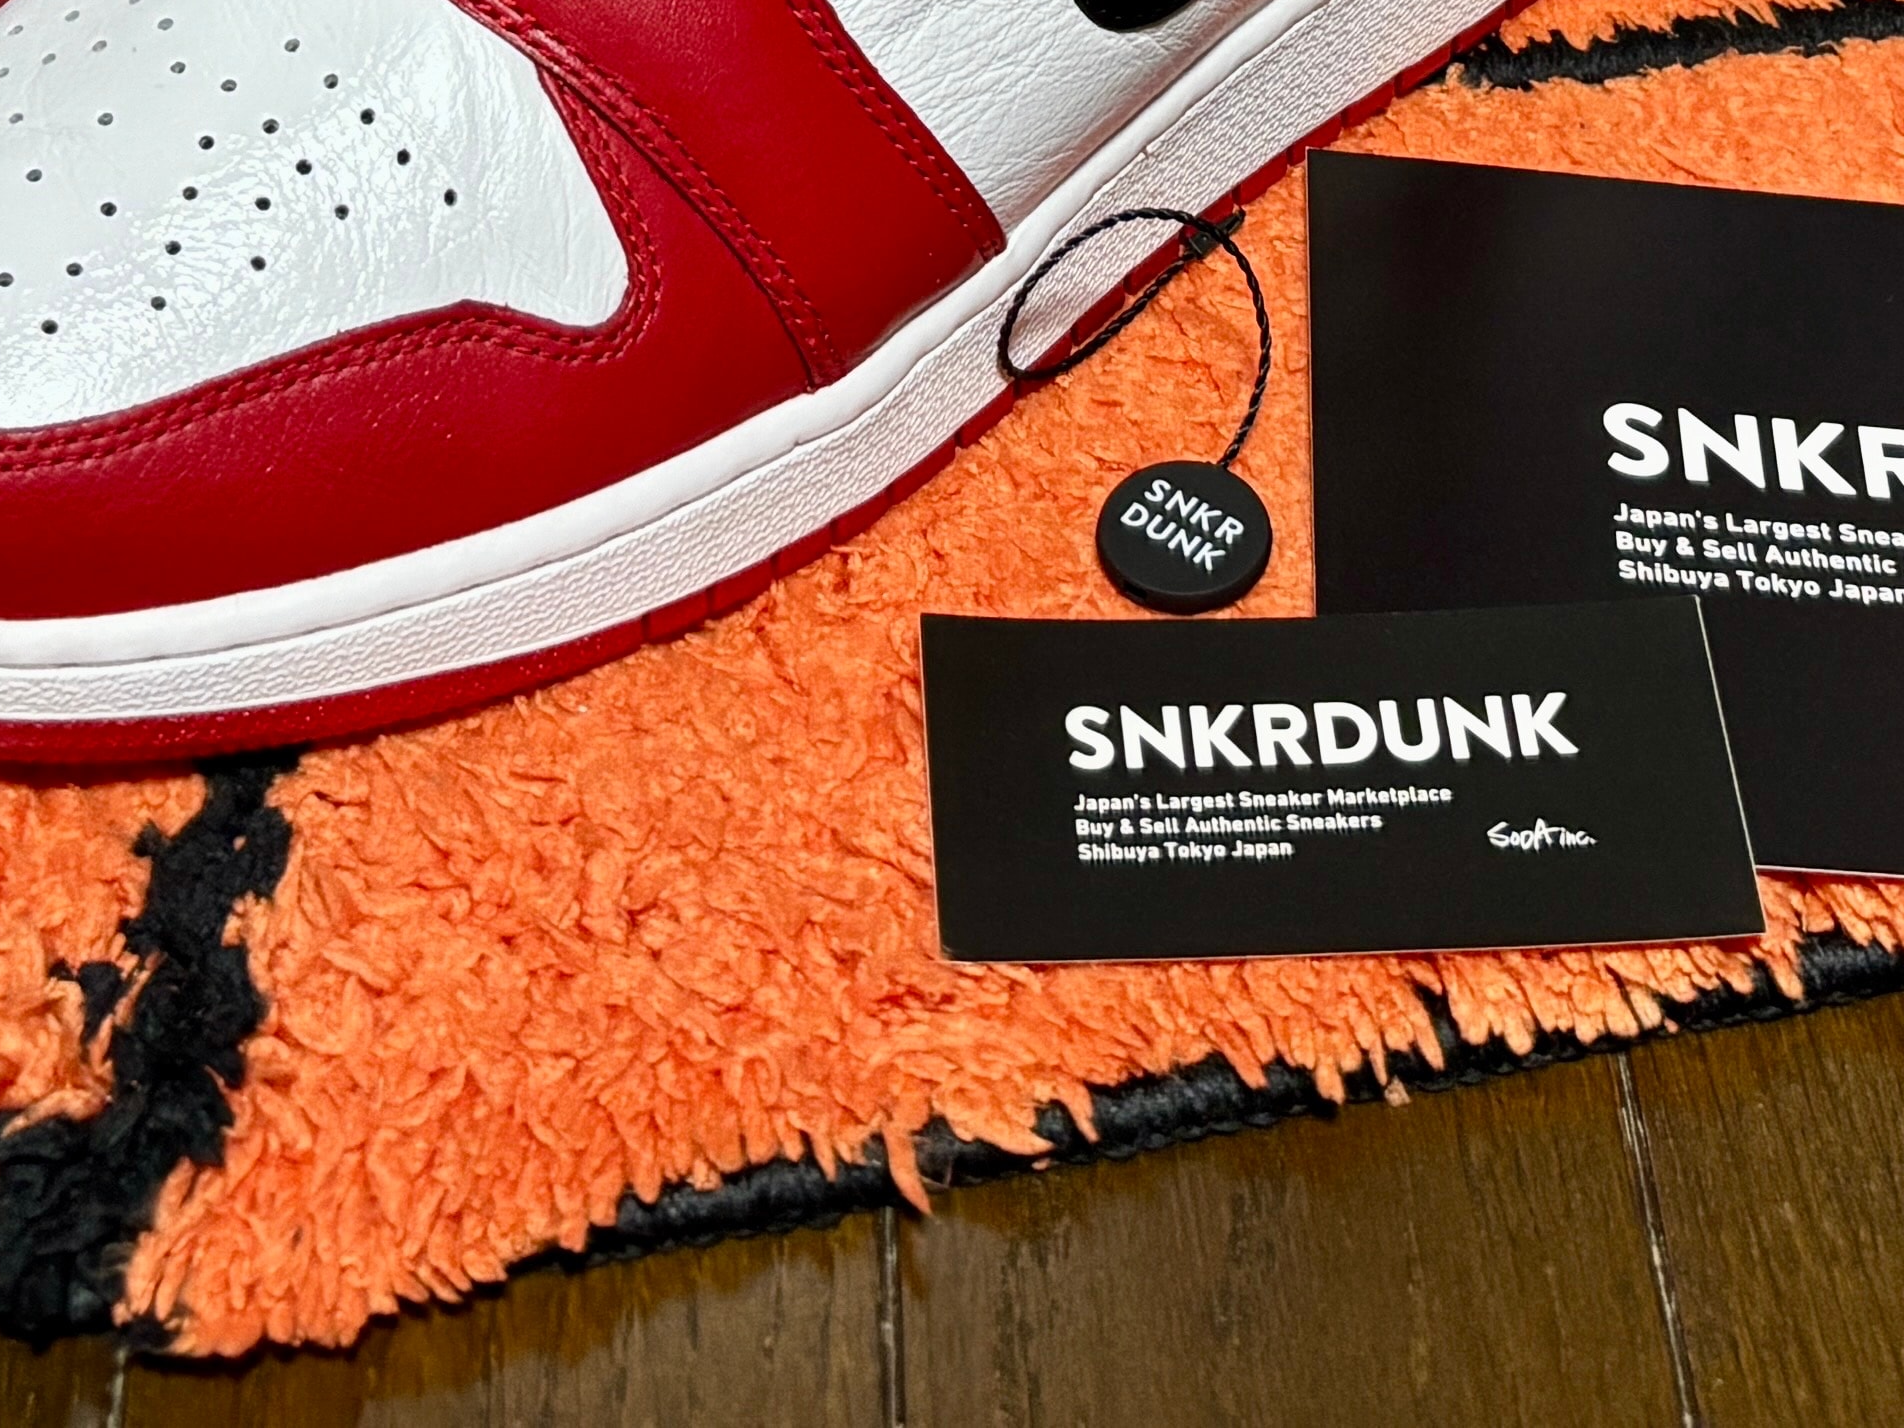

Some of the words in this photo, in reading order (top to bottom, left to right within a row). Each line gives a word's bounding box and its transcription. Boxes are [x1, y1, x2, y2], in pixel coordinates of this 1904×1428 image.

[1143, 478, 1245, 545] SNKR
[1612, 502, 1719, 530] Japan's
[1725, 512, 1832, 542] Largest
[1119, 501, 1227, 572] DUNK
[1615, 530, 1668, 557] Buy
[1675, 536, 1695, 557] &
[1702, 538, 1758, 563] Sell
[1764, 544, 1897, 575] Authentic
[1618, 559, 1731, 590] Shibuya
[1735, 569, 1821, 598] Tokyo
[1064, 691, 1580, 771] SNKRDUNK
[1073, 793, 1152, 815] Japan's
[1156, 792, 1235, 813] Largest
[1238, 789, 1323, 808] Sneaker
[1326, 785, 1453, 807] Marketplace
[1075, 818, 1114, 839] Buy
[1119, 817, 1135, 835] &
[1139, 817, 1181, 835] Sell
[1184, 815, 1283, 834] Authentic
[1286, 812, 1384, 831] Sneakers
[1077, 842, 1160, 863] Shibuya
[1163, 841, 1227, 862] Tokyo
[1231, 839, 1295, 861] Japan
